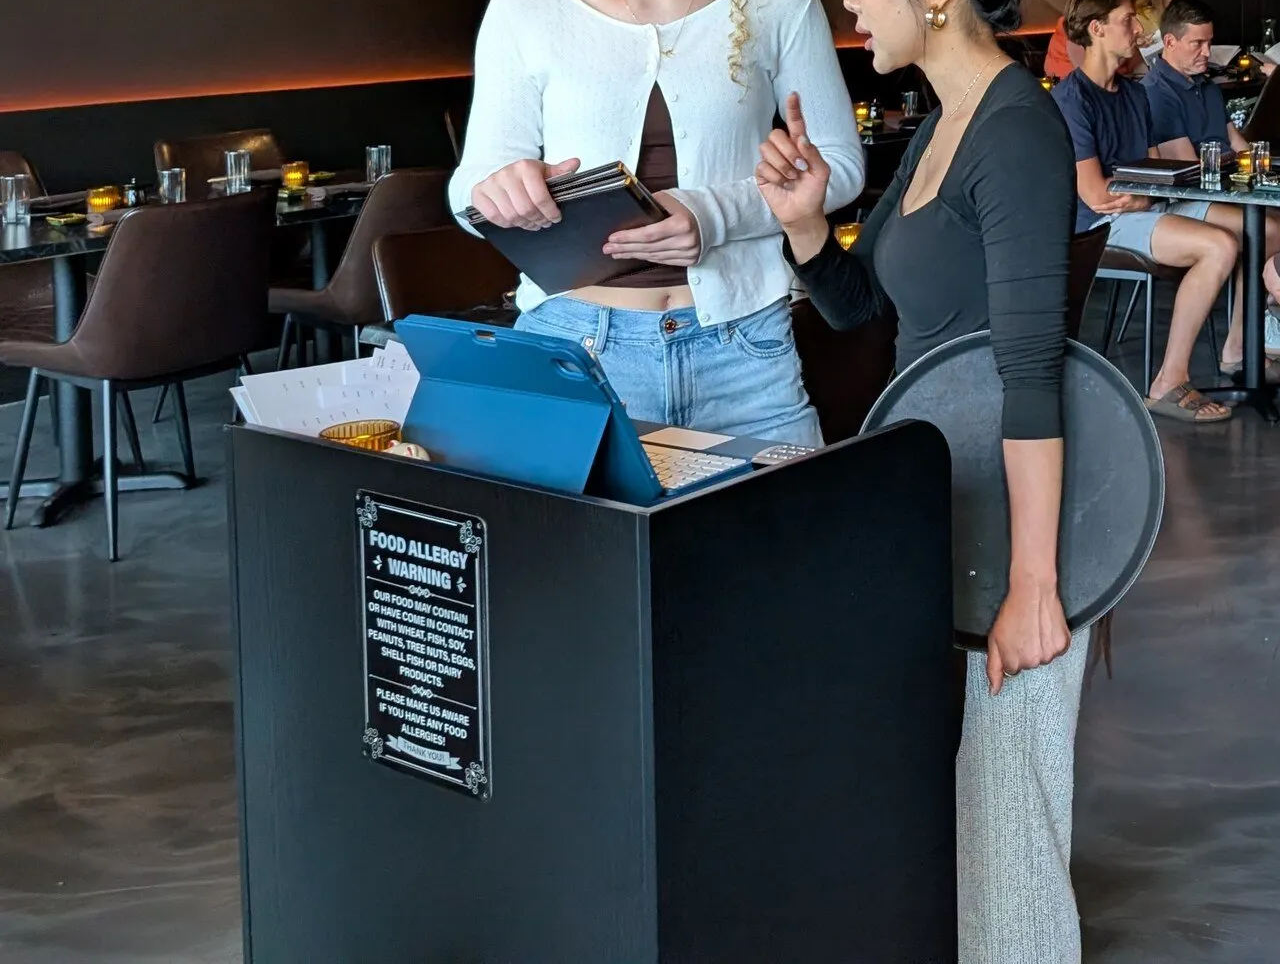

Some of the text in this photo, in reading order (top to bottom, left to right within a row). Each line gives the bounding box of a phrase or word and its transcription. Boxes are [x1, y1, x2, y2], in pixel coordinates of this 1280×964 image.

[369, 530, 468, 570] FOOD ALLERGY
[387, 558, 452, 590] WARNING
[368, 602, 474, 640] OR HAVE COME IN CONTACT
[373, 590, 468, 624] OUR FOOD MAY CONTAIN
[368, 628, 476, 671] PEANUTS, TREE NUTS, EGGS,
[376, 618, 466, 654] WITH WHEAT, FISH, SOY,
[381, 646, 462, 679] SHELL FISH OR DAIRY
[399, 666, 444, 687] PRODUCTS.
[376, 688, 470, 726] PLEASE MAKE US AWARE
[379, 702, 468, 739] IF YOU HAVE ANY FOOD
[401, 723, 446, 746] ALLERGIES!
